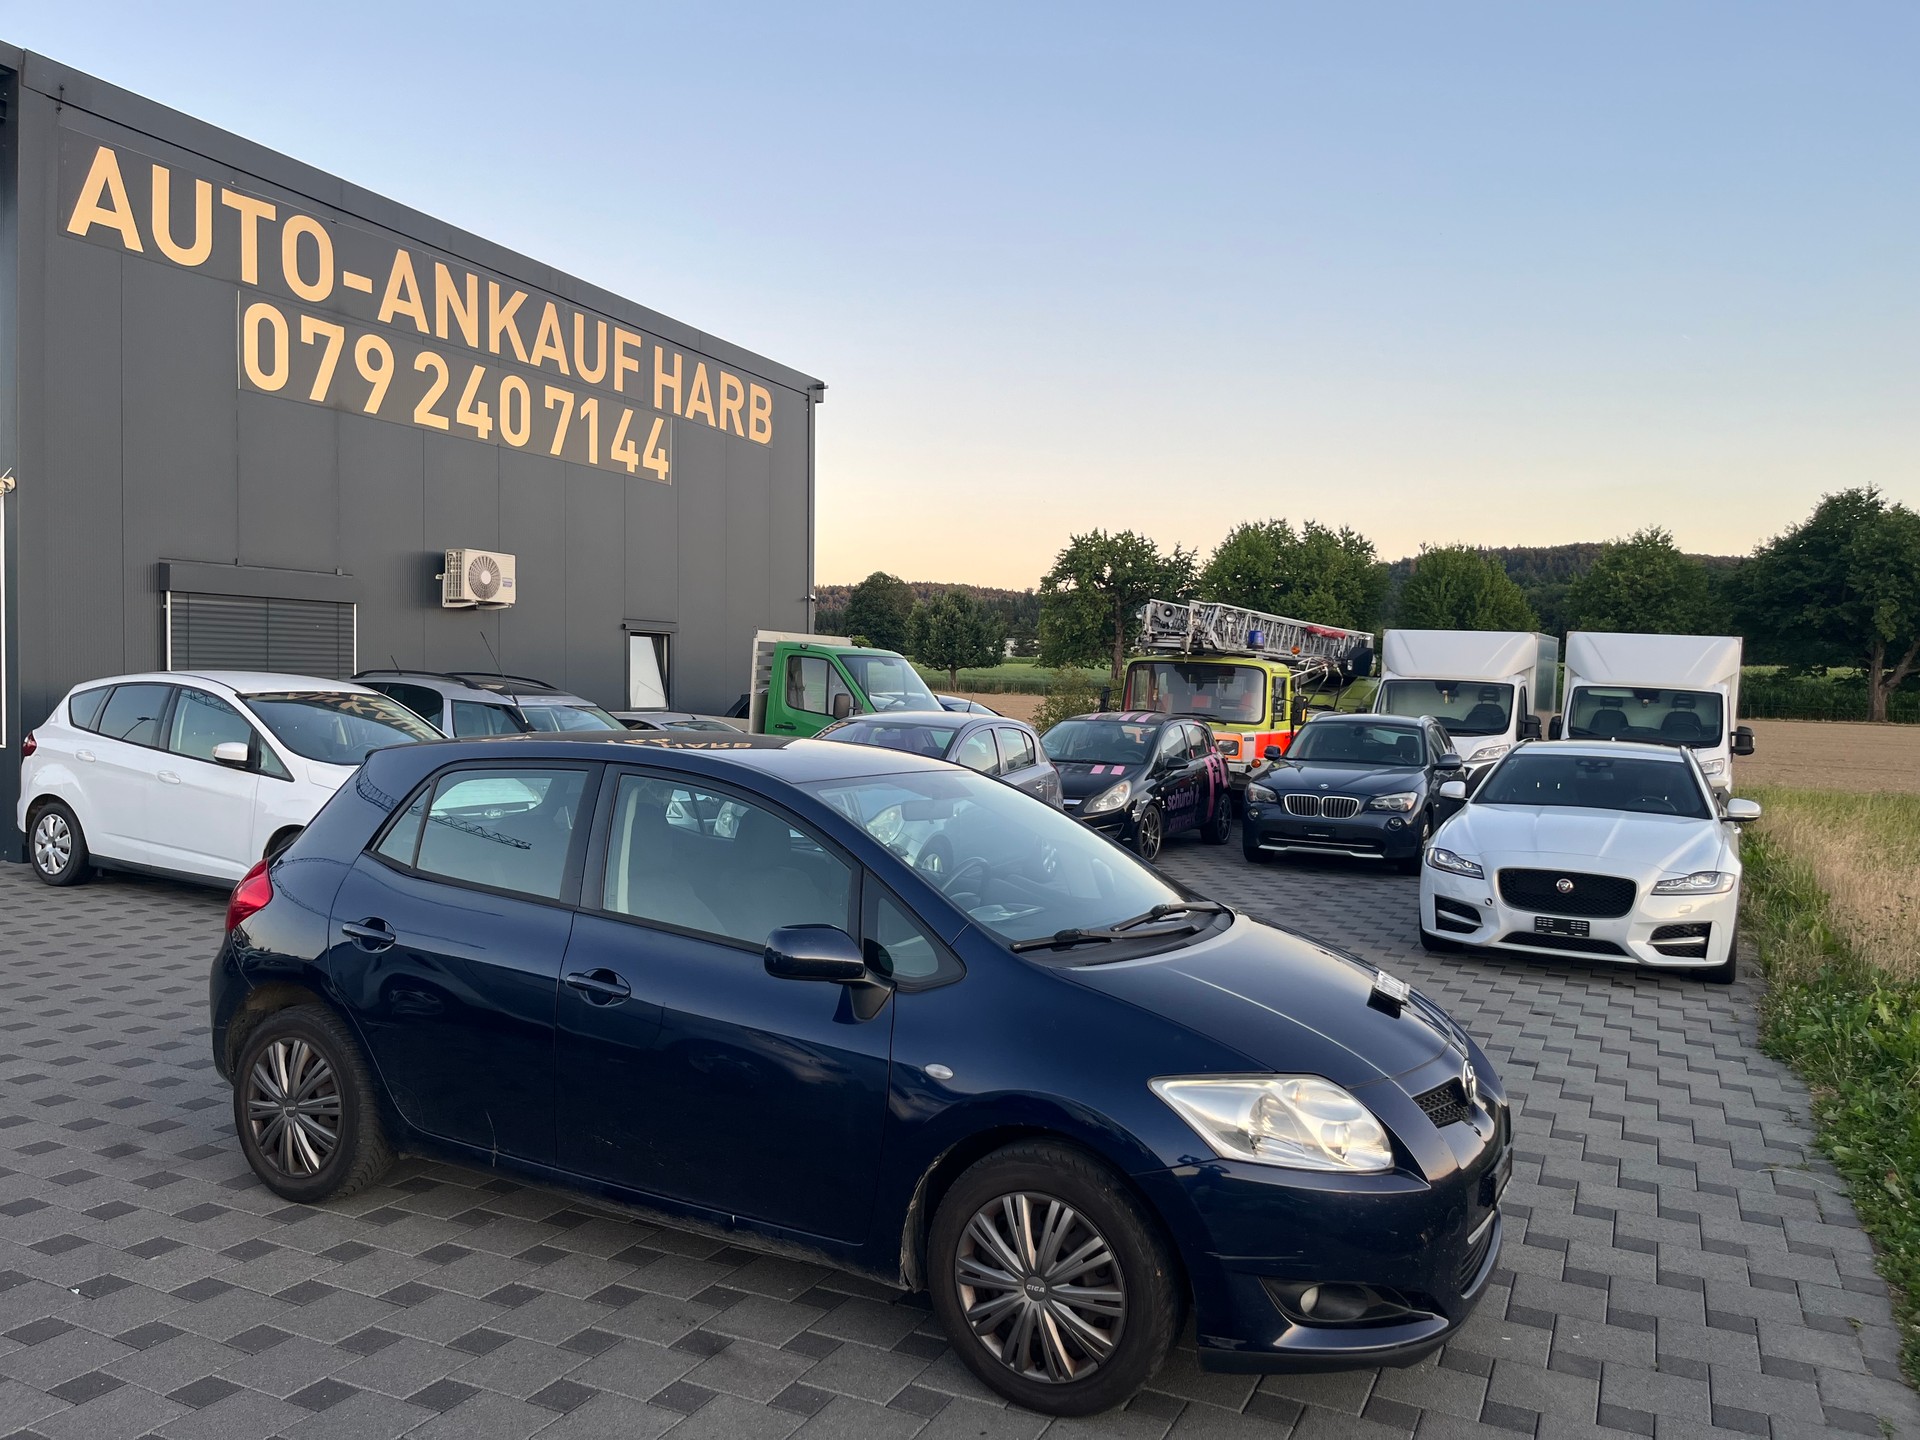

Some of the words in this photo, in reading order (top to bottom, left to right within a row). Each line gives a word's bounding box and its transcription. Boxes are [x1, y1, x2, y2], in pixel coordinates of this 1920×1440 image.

[66, 146, 642, 392] AUTO-ANKAUF
[653, 345, 773, 445] HARB
[243, 302, 395, 415] 079
[413, 351, 531, 448] 240
